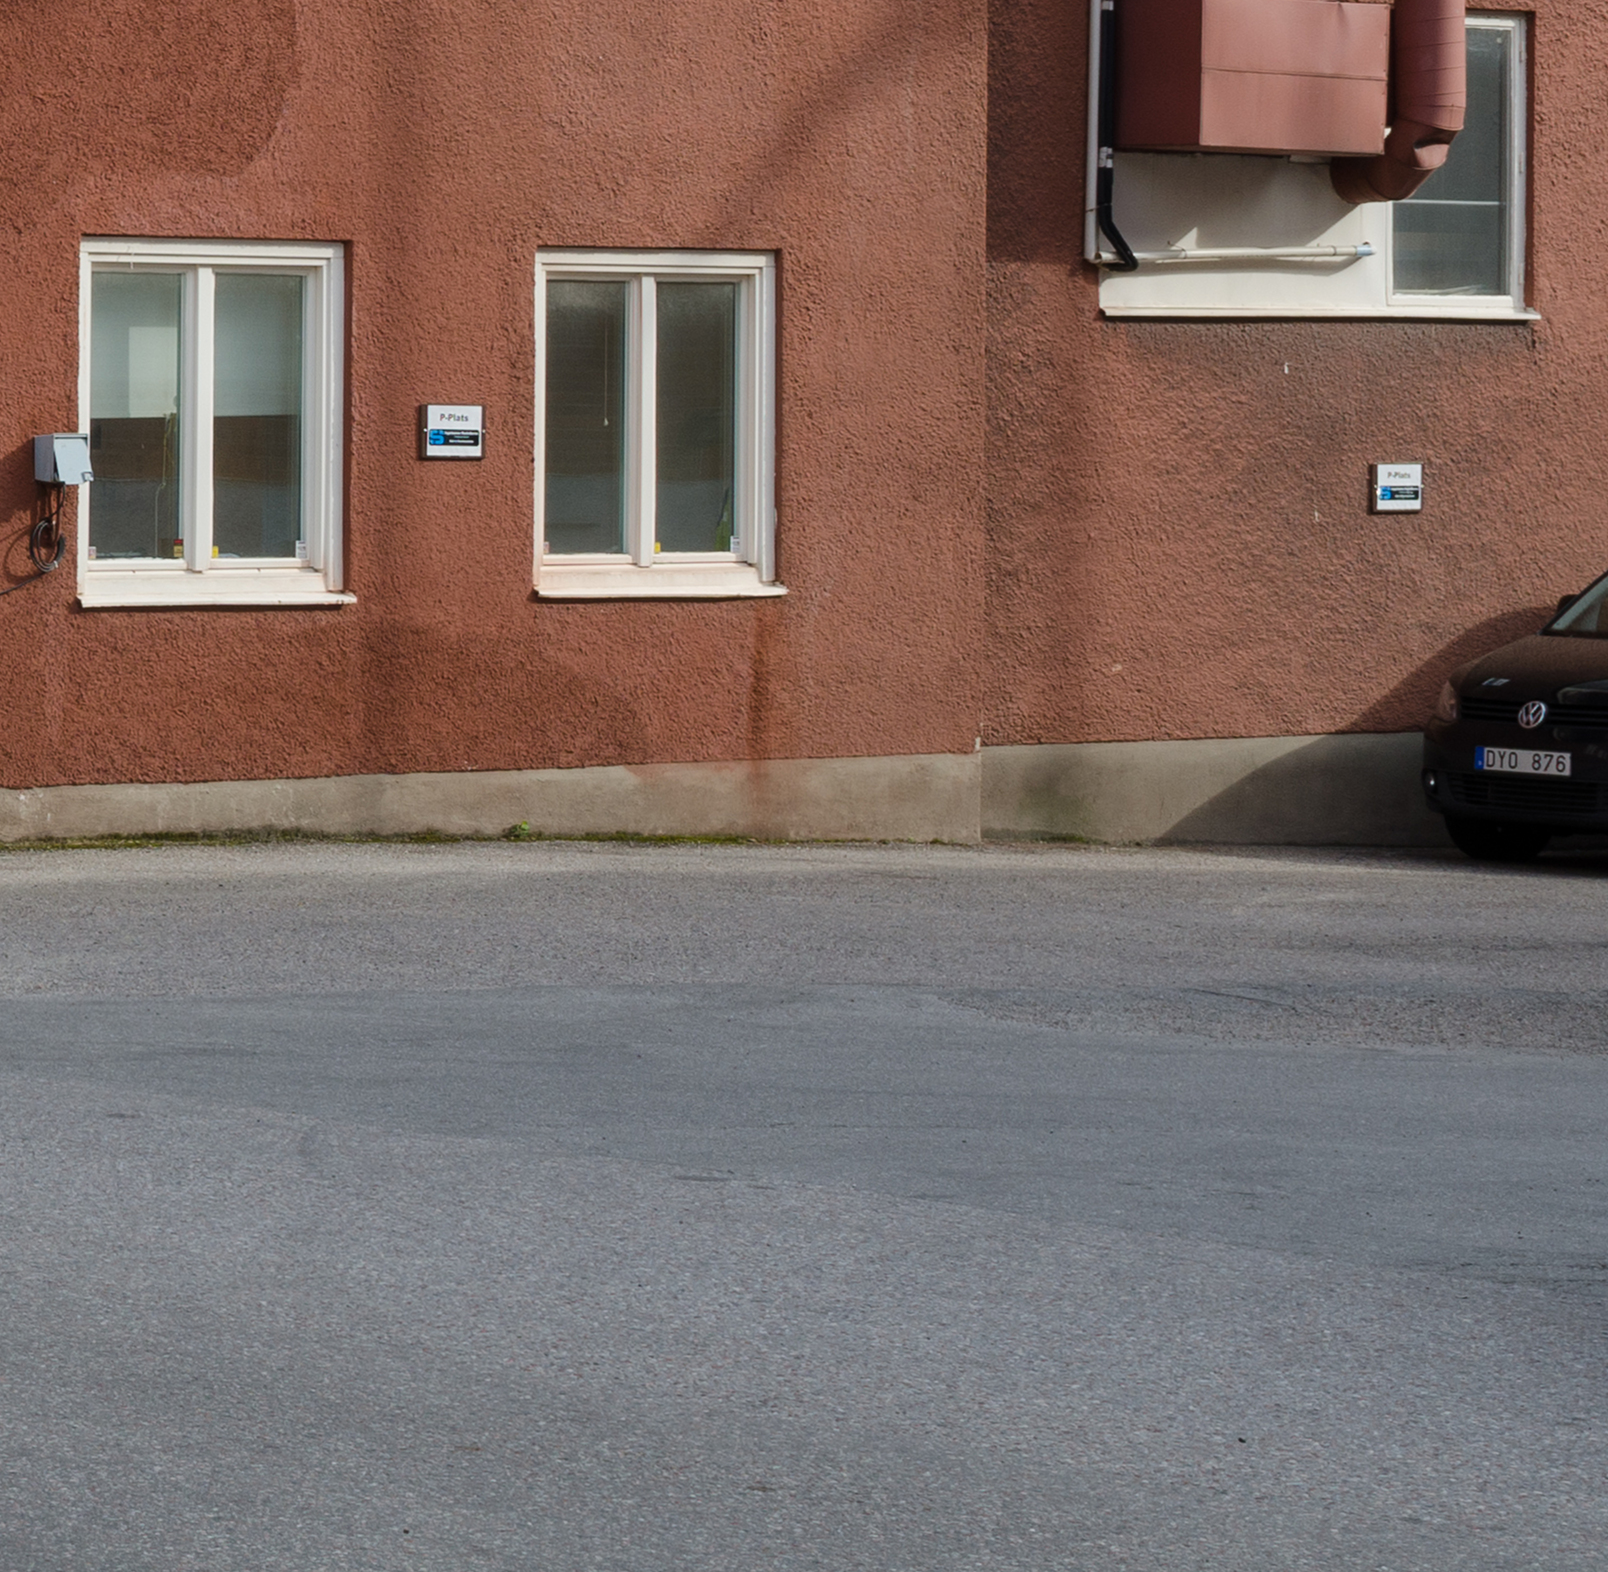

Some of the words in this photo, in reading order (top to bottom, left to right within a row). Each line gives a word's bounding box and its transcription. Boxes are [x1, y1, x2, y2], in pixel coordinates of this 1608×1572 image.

[439, 413, 469, 422] P-Plats
[1486, 749, 1518, 769] DYO
[1531, 753, 1566, 773] 876
